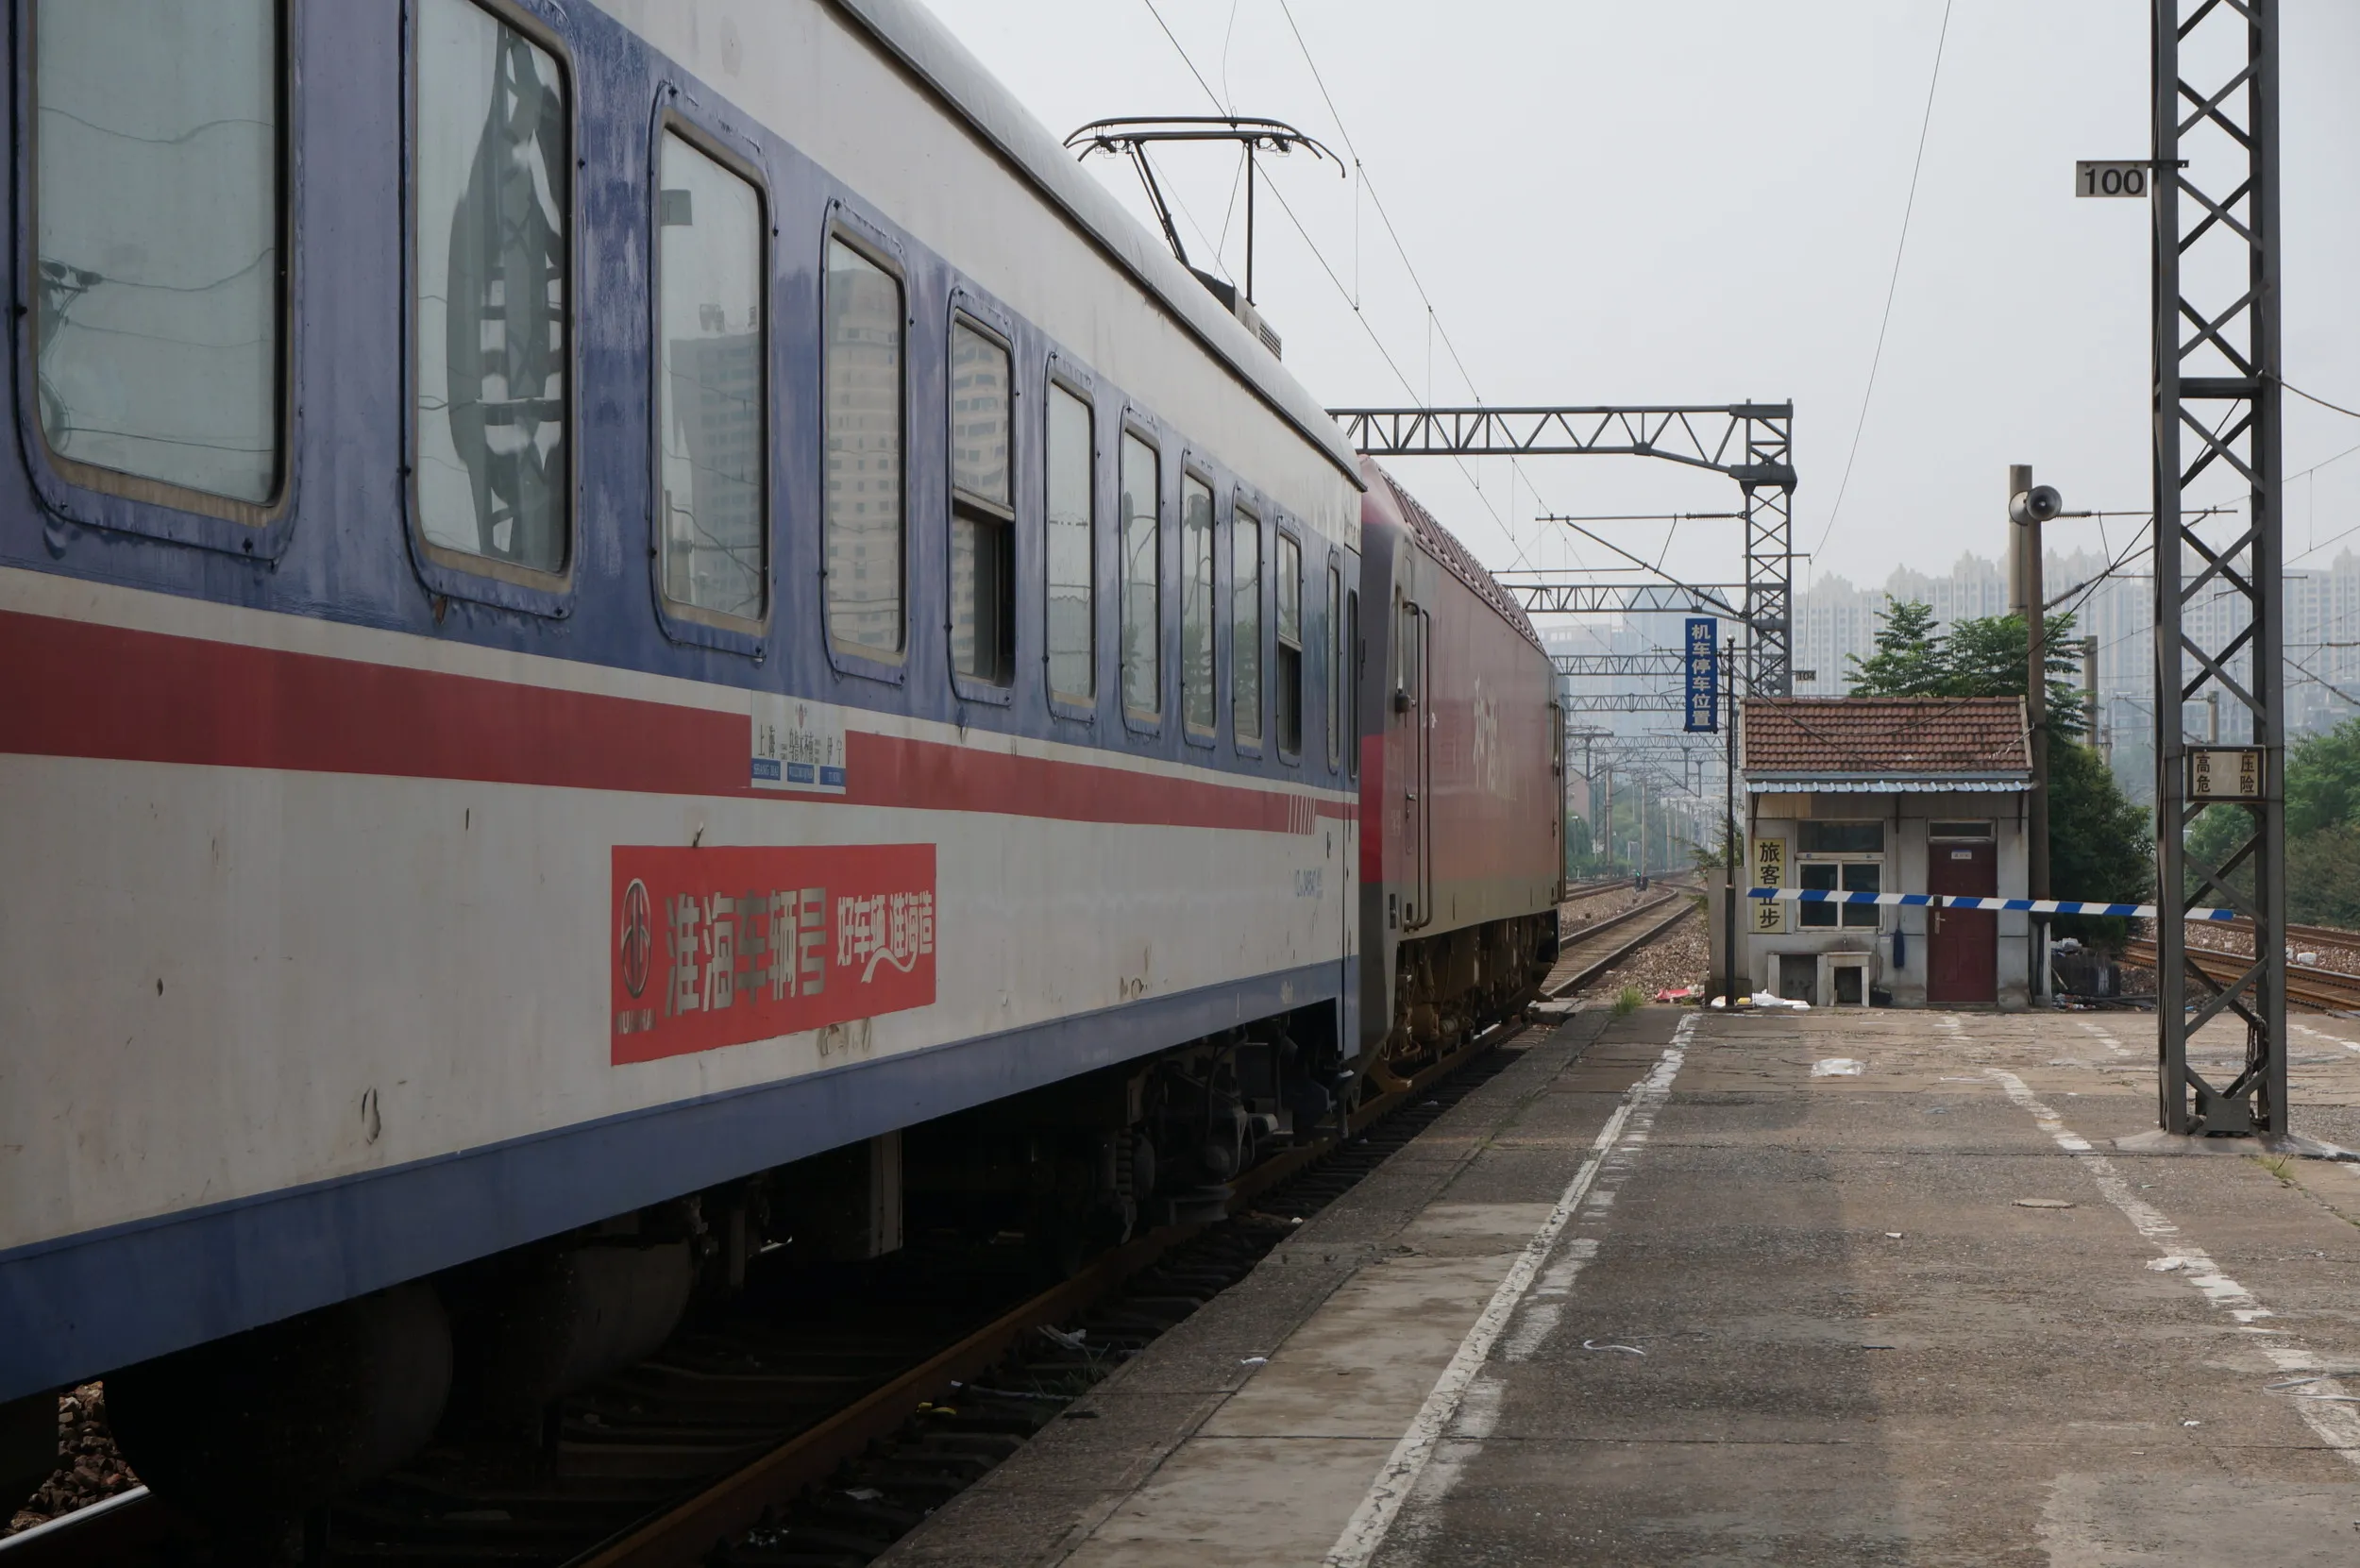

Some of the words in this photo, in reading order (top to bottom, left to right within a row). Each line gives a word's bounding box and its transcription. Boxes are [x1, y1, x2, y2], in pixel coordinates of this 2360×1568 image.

[2084, 168, 2144, 195] 100
[1691, 624, 1711, 726] 机车停车位置
[1798, 671, 1815, 681] 104
[665, 887, 827, 1019] 淮海车辆号
